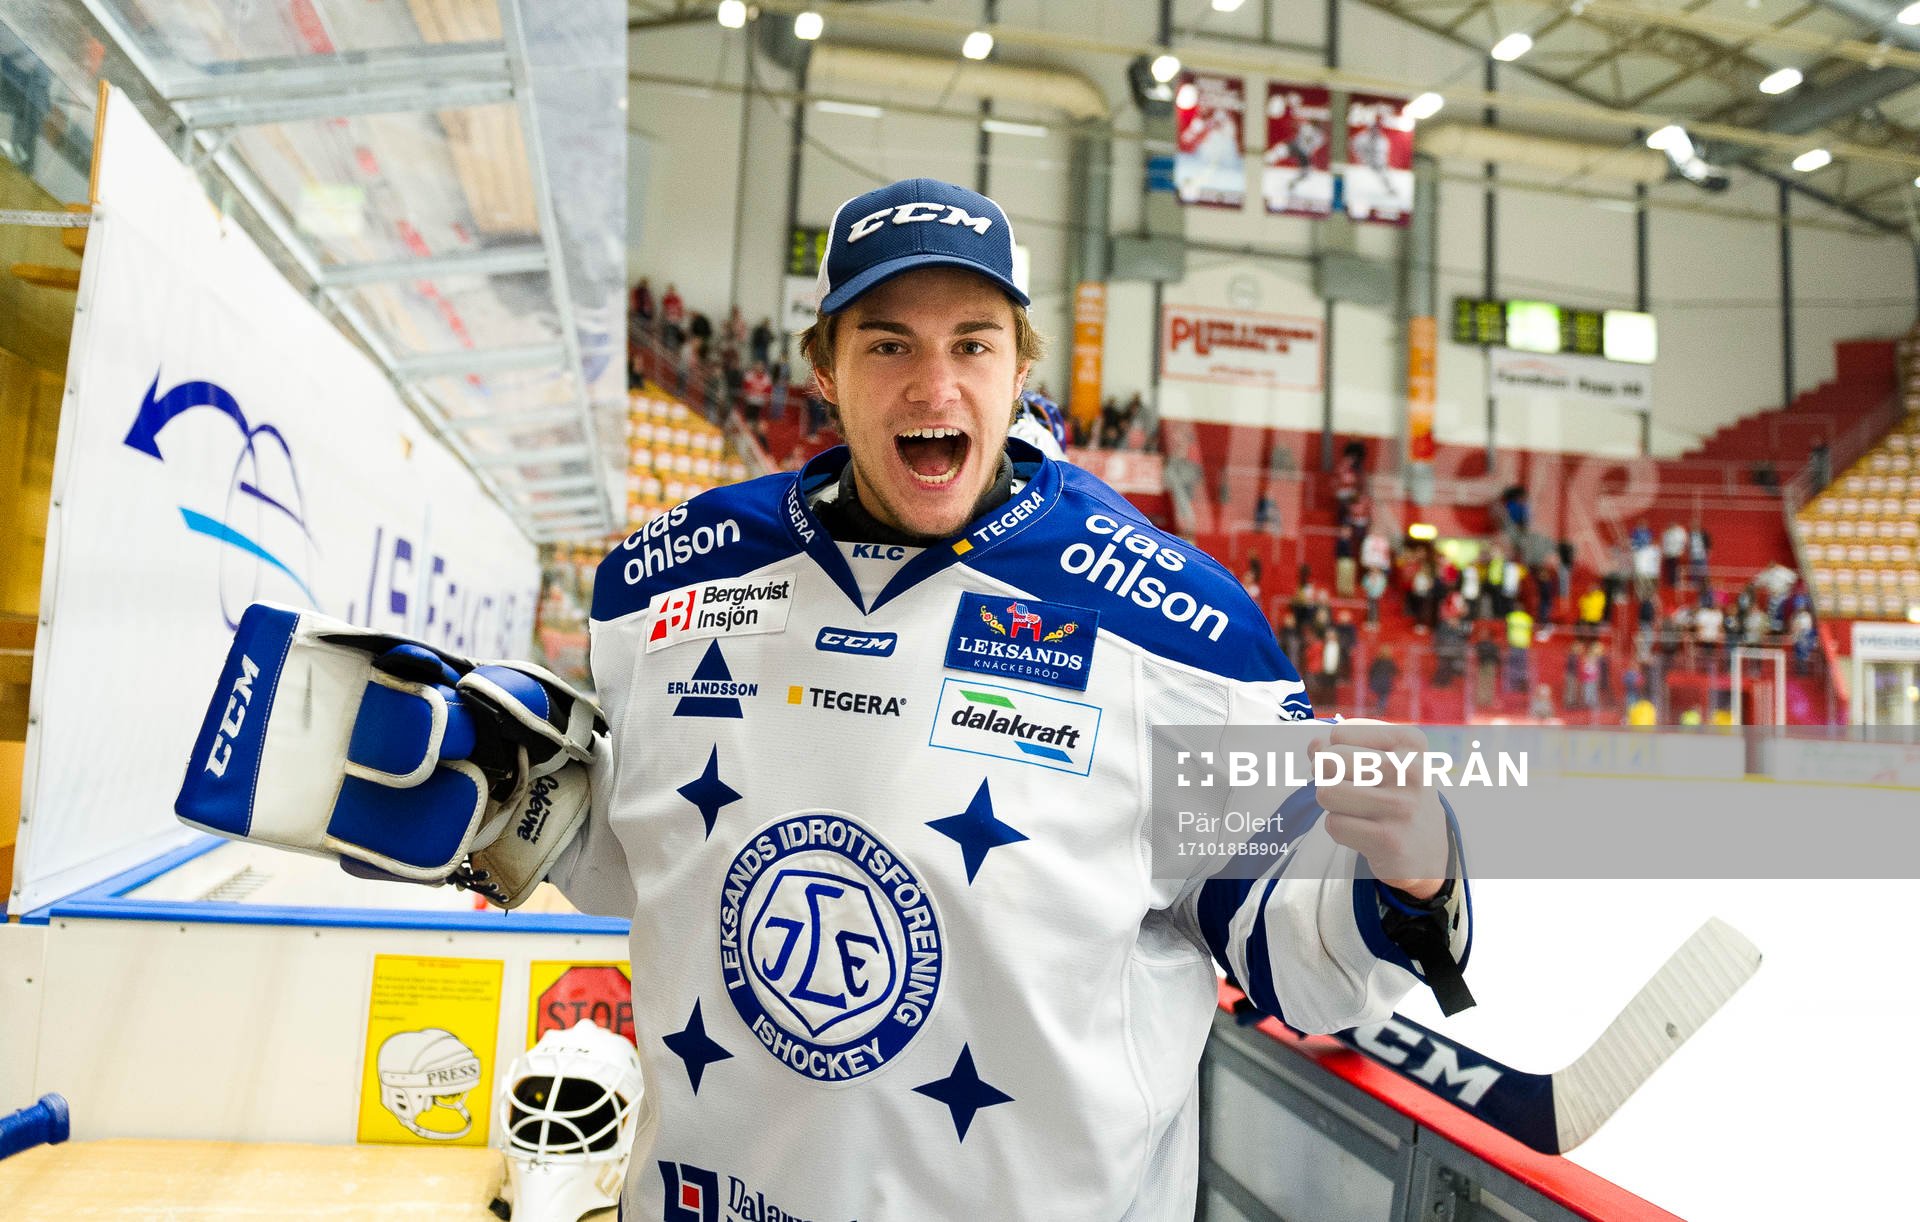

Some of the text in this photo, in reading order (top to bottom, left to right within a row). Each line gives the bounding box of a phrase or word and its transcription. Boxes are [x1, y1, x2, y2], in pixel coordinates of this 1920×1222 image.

[848, 202, 992, 243] CCM
[787, 481, 816, 544] TEGERA
[973, 490, 1045, 543] TEGERA
[624, 519, 741, 585] ohlson
[852, 544, 905, 561] KLC
[1085, 514, 1187, 572] clas
[703, 580, 789, 605] Bergkvist
[1060, 543, 1229, 642] ohlson
[698, 608, 758, 631] Insjön
[820, 632, 894, 650] CCM
[957, 637, 1083, 671] LEKSANDS
[667, 681, 758, 697] ERLANDSSON
[973, 658, 1059, 680] KNÄCKEBRÖD
[204, 654, 260, 778] CCM
[951, 705, 1080, 749] dalakraft
[721, 819, 938, 1028] LEKSANDS IDROTTSFÖRENING
[548, 1001, 634, 1034] STOP
[752, 1014, 884, 1079] ISHOCKEY
[1353, 1018, 1504, 1107] CM
[427, 1064, 477, 1087] PRESS
